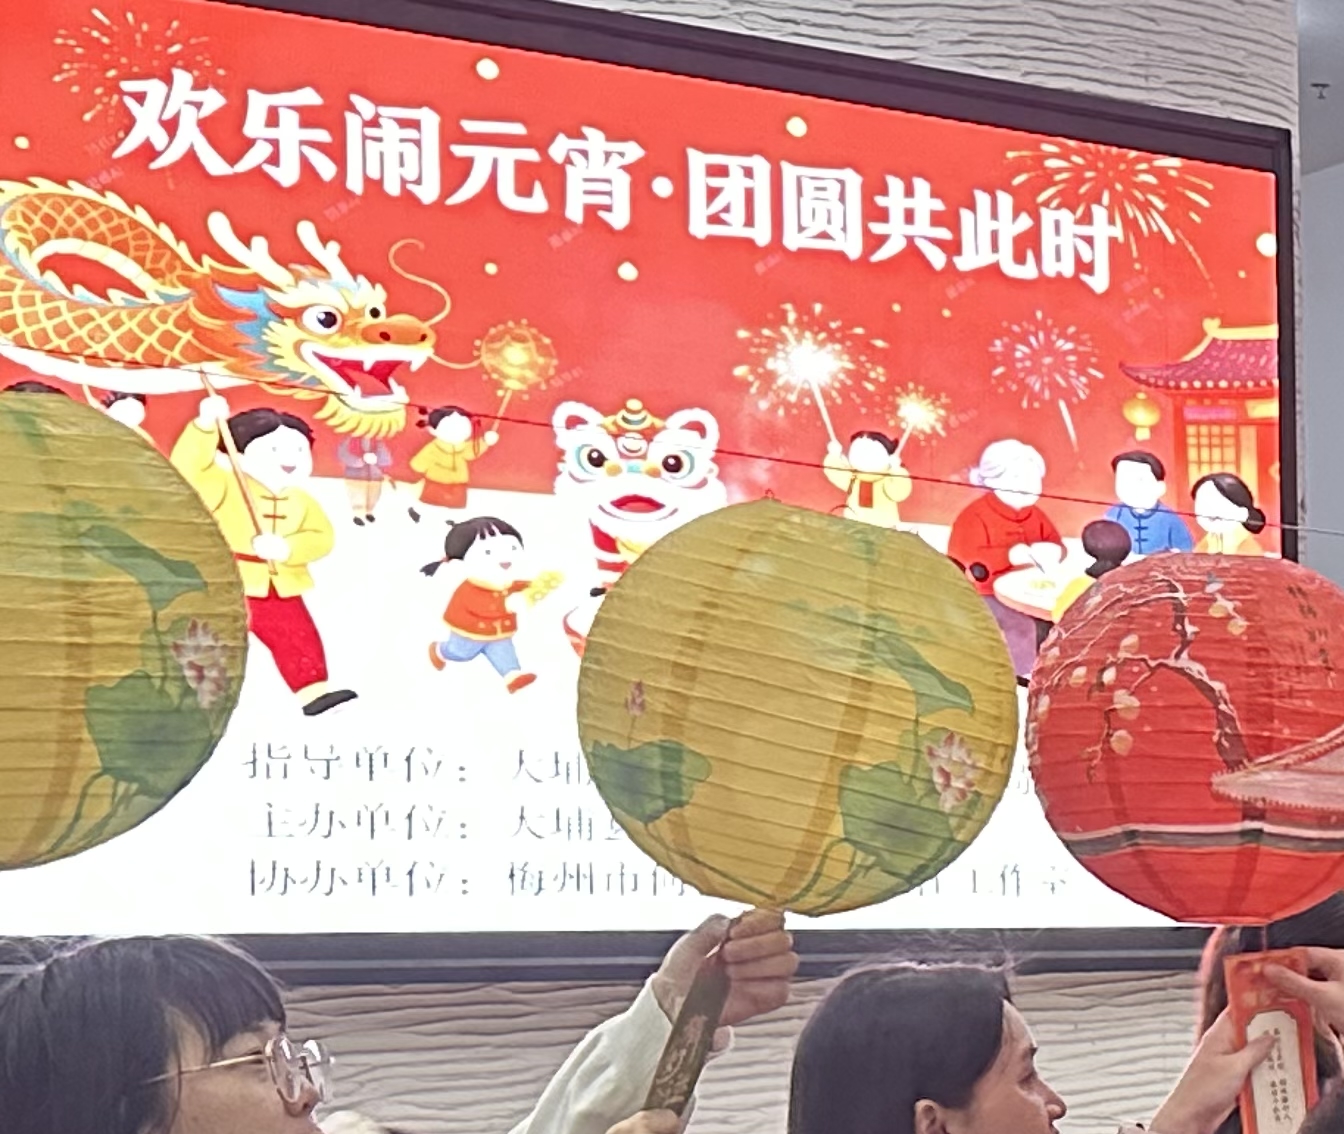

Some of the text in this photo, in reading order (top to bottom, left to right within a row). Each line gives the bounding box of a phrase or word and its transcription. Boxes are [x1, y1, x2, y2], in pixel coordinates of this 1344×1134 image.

[112, 66, 1119, 294] 欢乐闹元宵·团圆共此时
